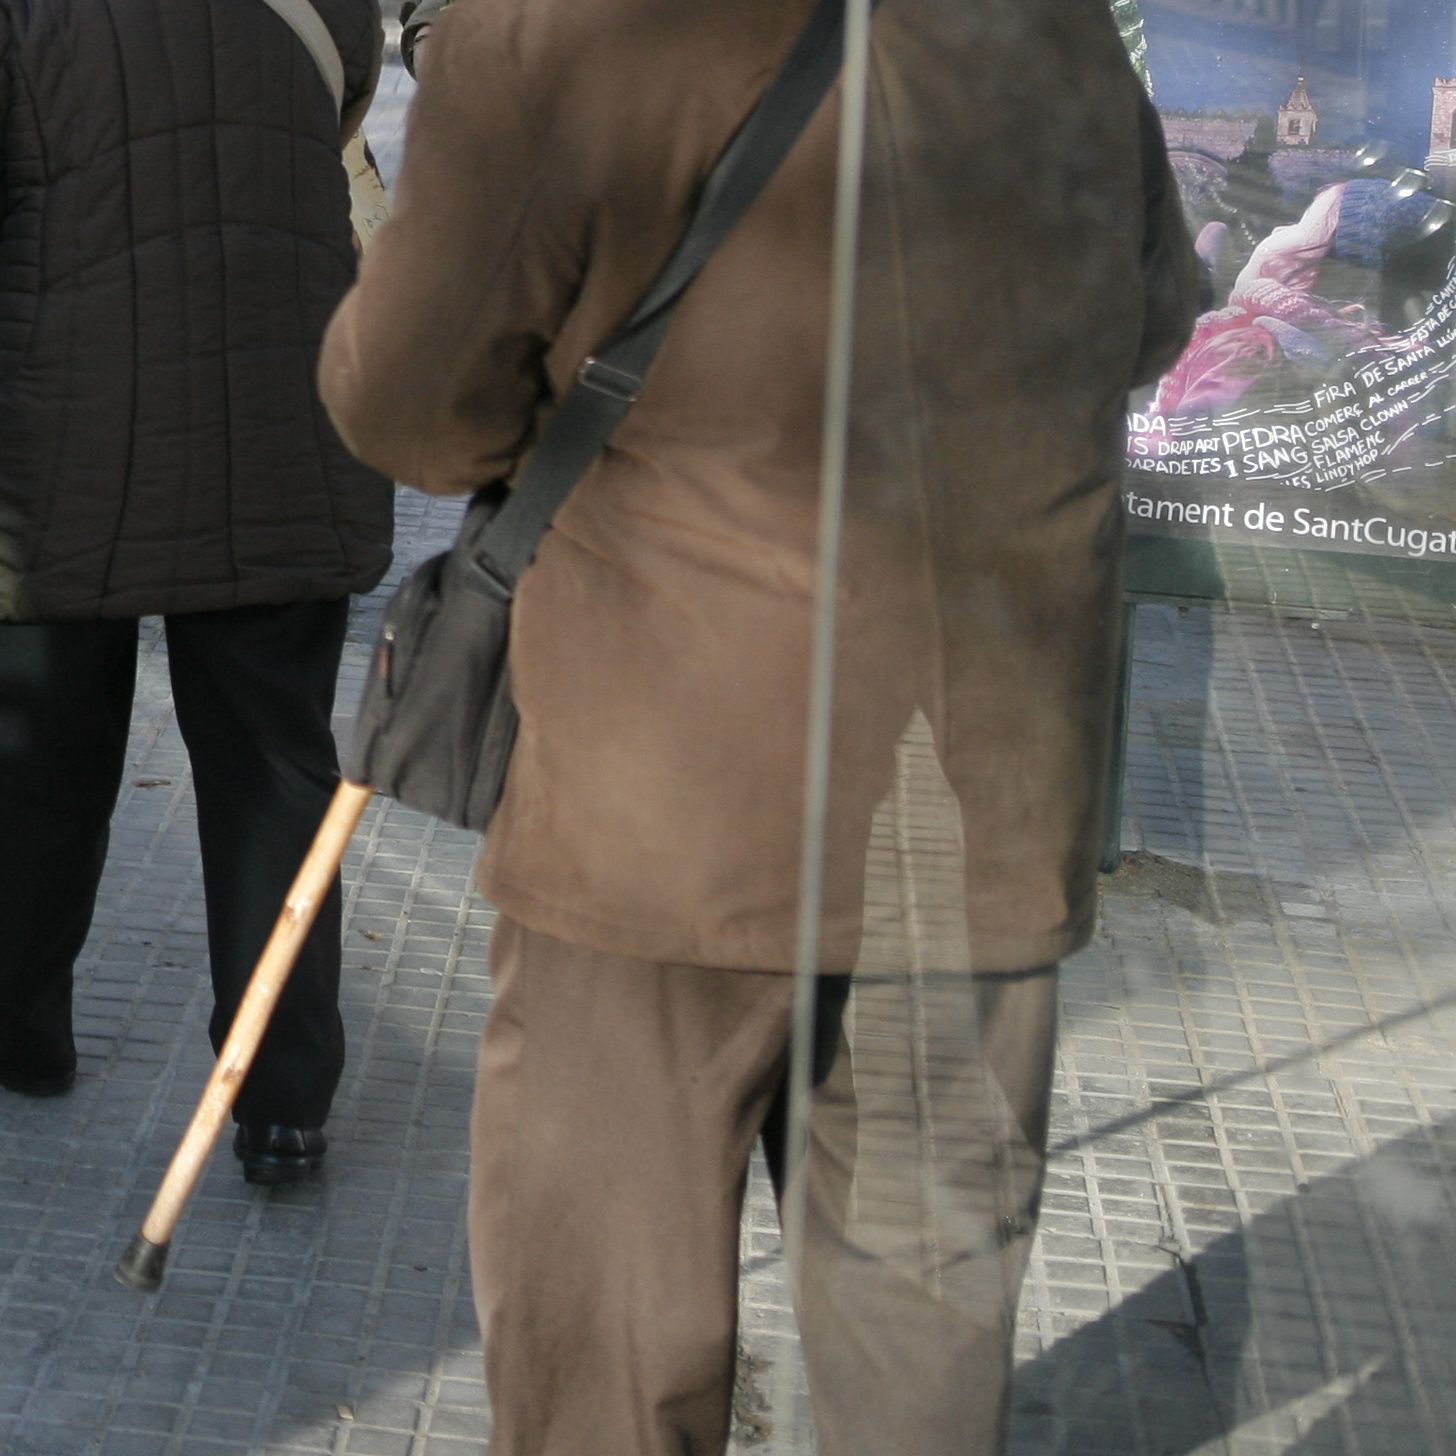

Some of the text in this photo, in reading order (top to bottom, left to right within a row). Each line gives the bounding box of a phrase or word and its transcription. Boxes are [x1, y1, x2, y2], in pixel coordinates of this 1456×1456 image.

[1361, 369, 1386, 389] DE
[1383, 345, 1436, 377] SANTA
[1367, 391, 1386, 410] AL
[1387, 371, 1430, 397] CARRER
[1311, 399, 1409, 456] SALSA CLOWN
[1242, 445, 1310, 475] SANG
[1313, 430, 1386, 470] FLAMENC
[1121, 490, 1235, 528] tament
[1244, 501, 1285, 533] de
